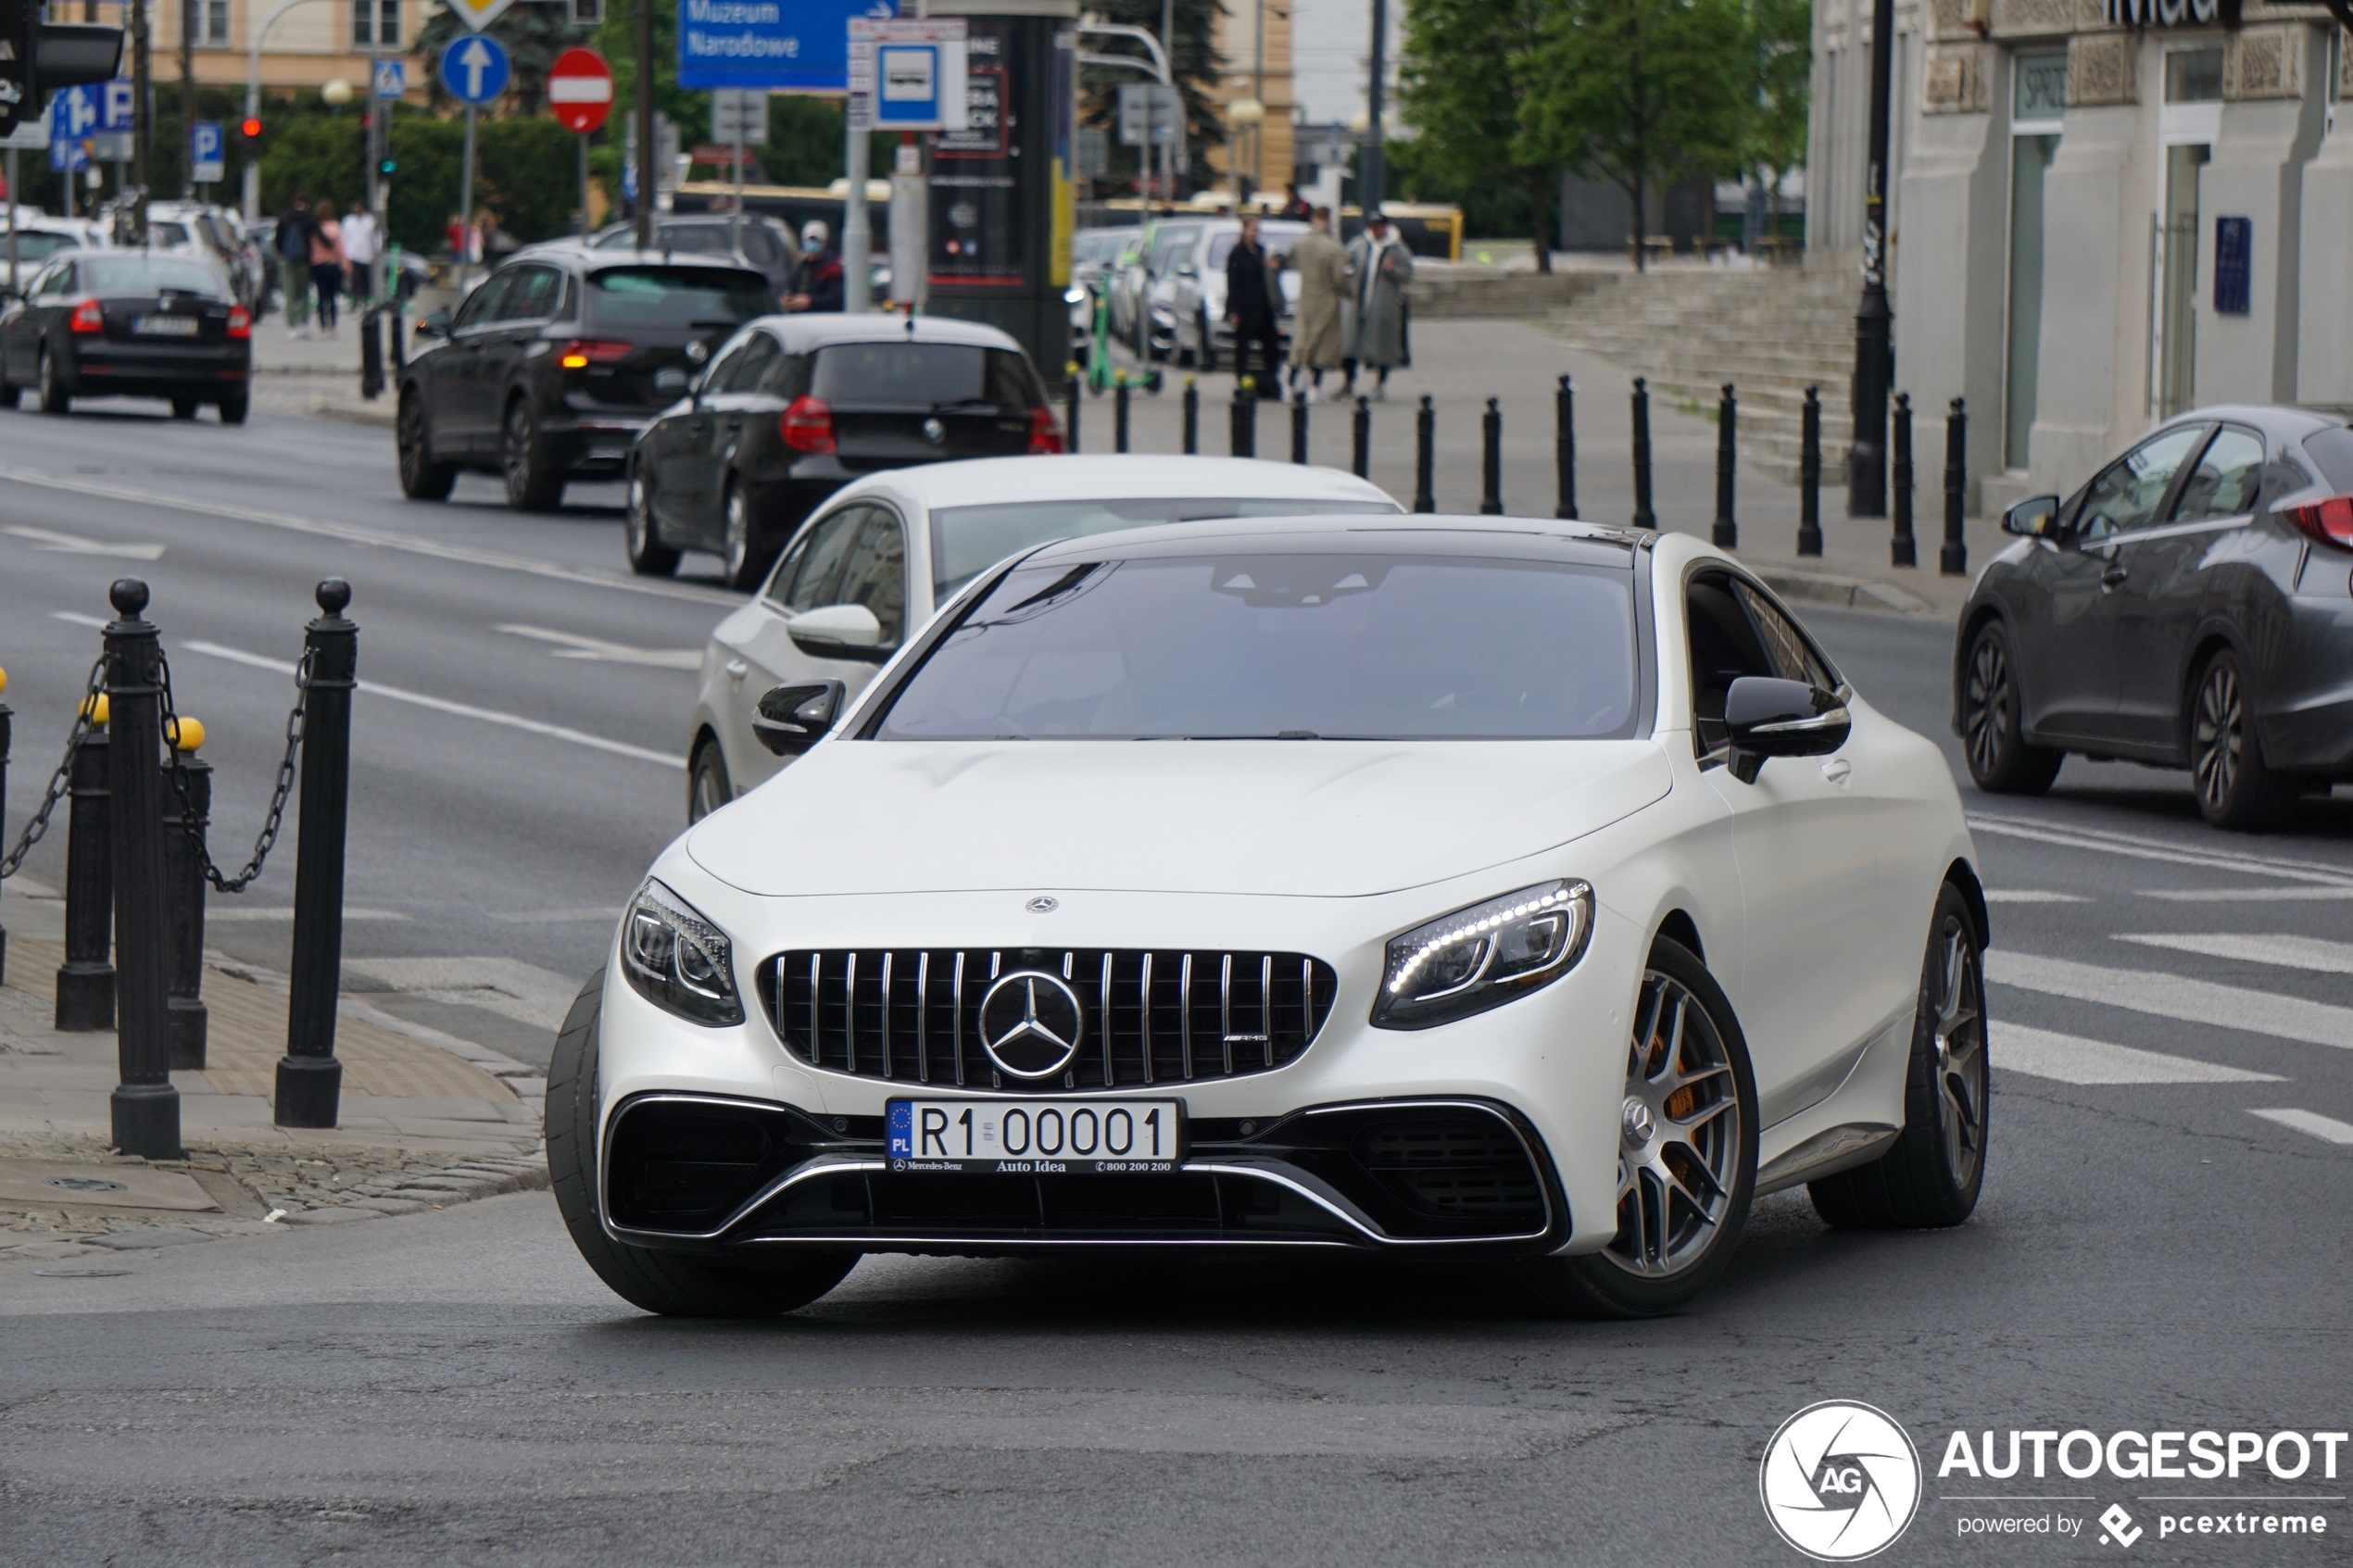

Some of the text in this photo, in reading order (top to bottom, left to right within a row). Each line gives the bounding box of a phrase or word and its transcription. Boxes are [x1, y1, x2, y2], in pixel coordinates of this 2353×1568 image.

[688, 0, 779, 23] Muzeum
[688, 31, 799, 58] Narodowe
[921, 1108, 1160, 1156] R1 00001
[892, 1138, 910, 1152] PL
[907, 1160, 963, 1171] Mercedes-Benz
[996, 1160, 1066, 1173] Auto Idea
[1106, 1162, 1171, 1172] 800 200 200
